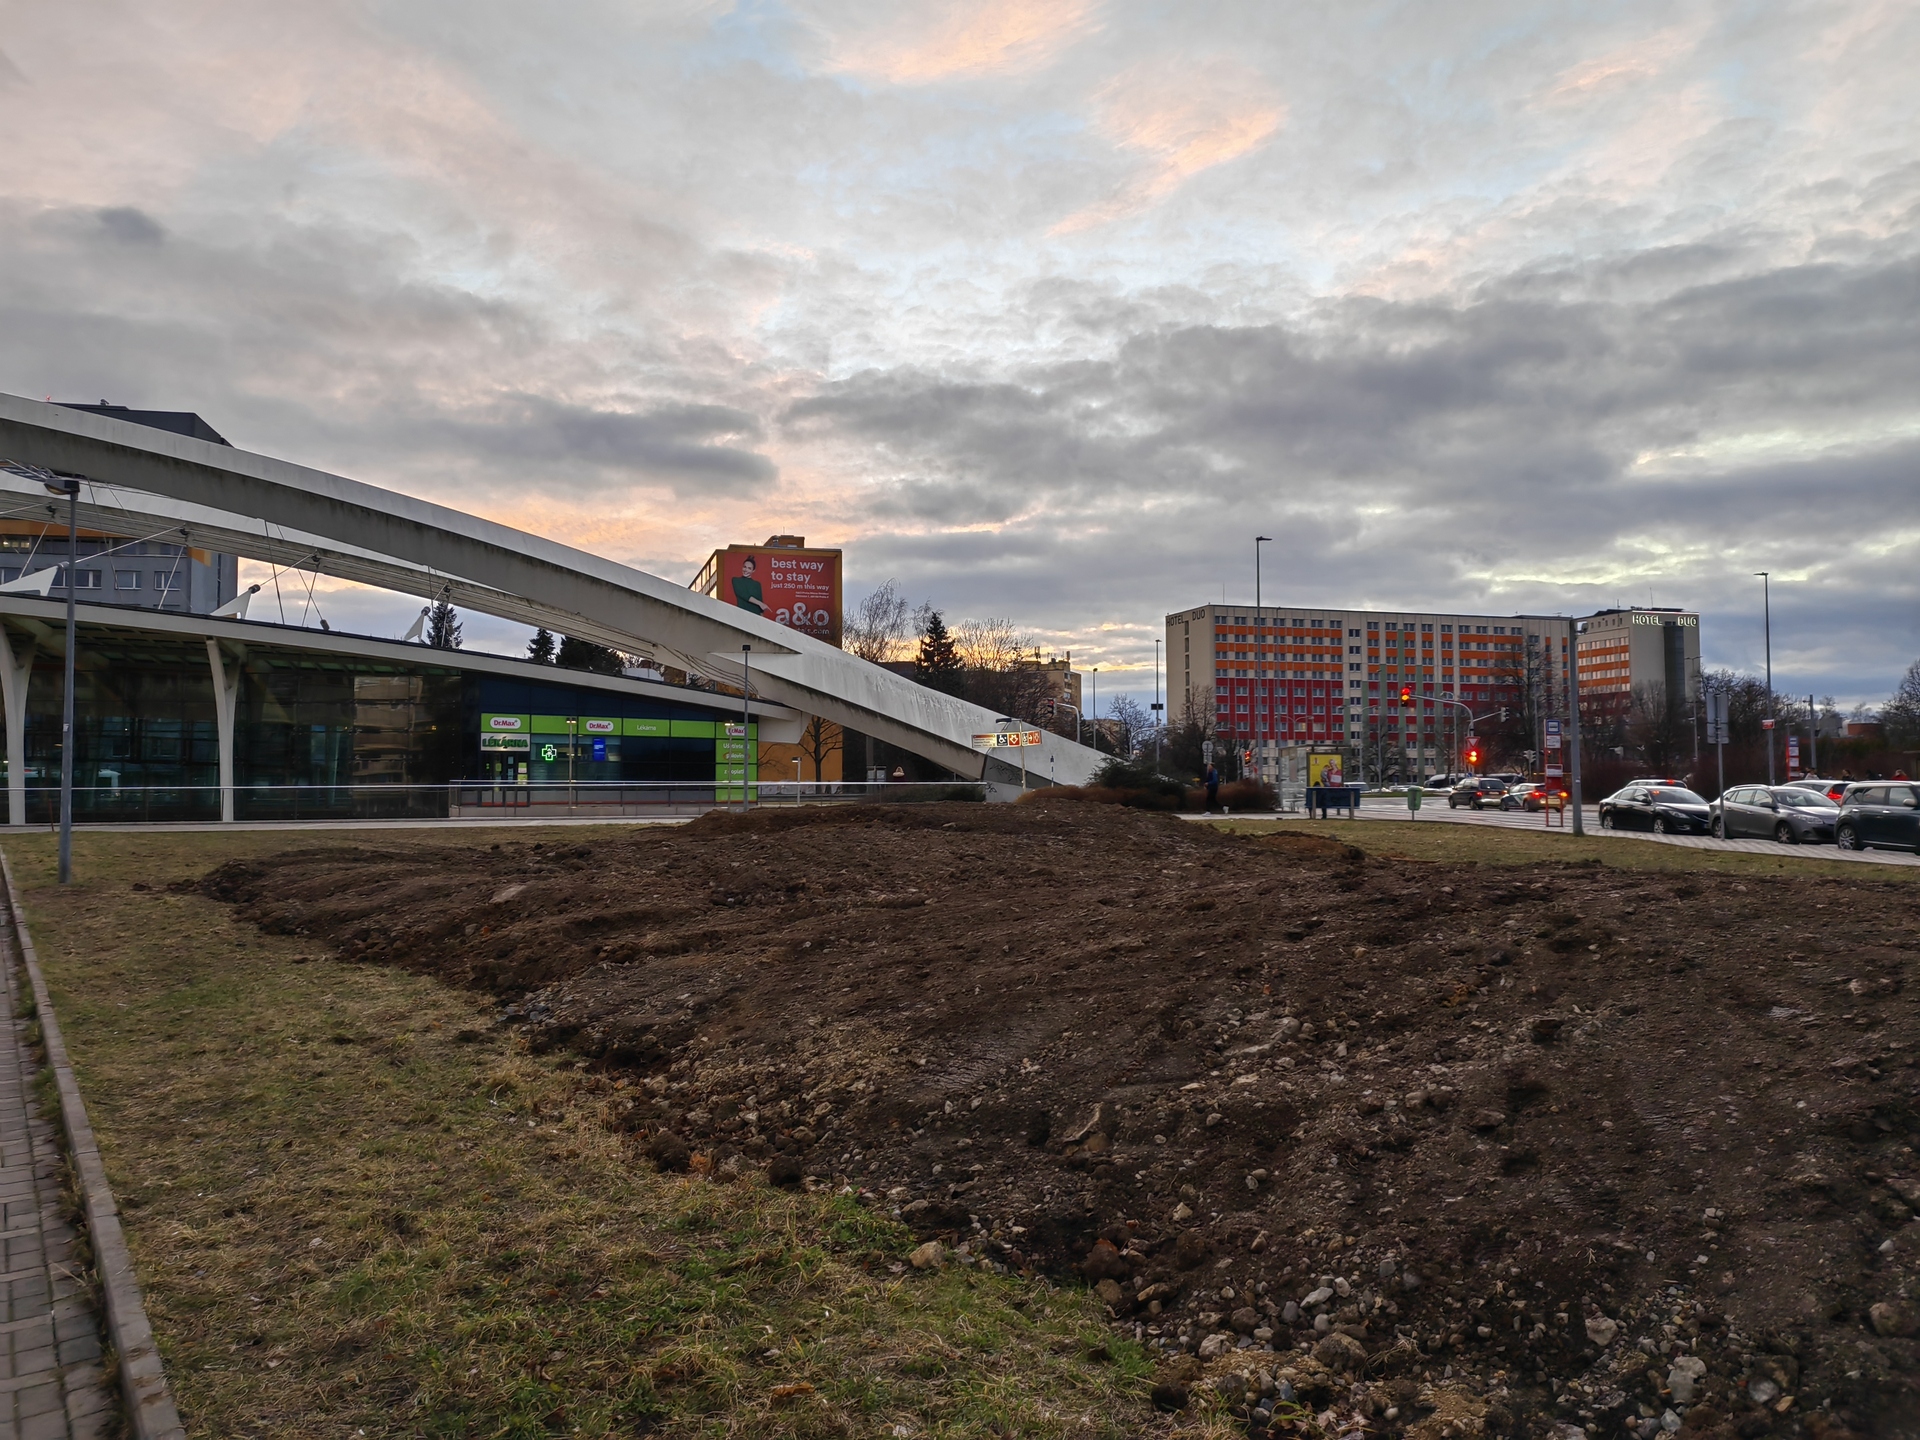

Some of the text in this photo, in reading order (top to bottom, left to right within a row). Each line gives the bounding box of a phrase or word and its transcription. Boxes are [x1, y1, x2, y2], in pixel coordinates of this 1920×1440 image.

[771, 558, 824, 572] best way
[771, 571, 811, 584] to stay
[775, 602, 830, 627] a&o
[1166, 609, 1206, 627] HOTEL DUO
[1632, 614, 1698, 627] HOTEL DUO
[493, 719, 516, 727] Dr.Max
[482, 736, 529, 749] LÉKÁRNA
